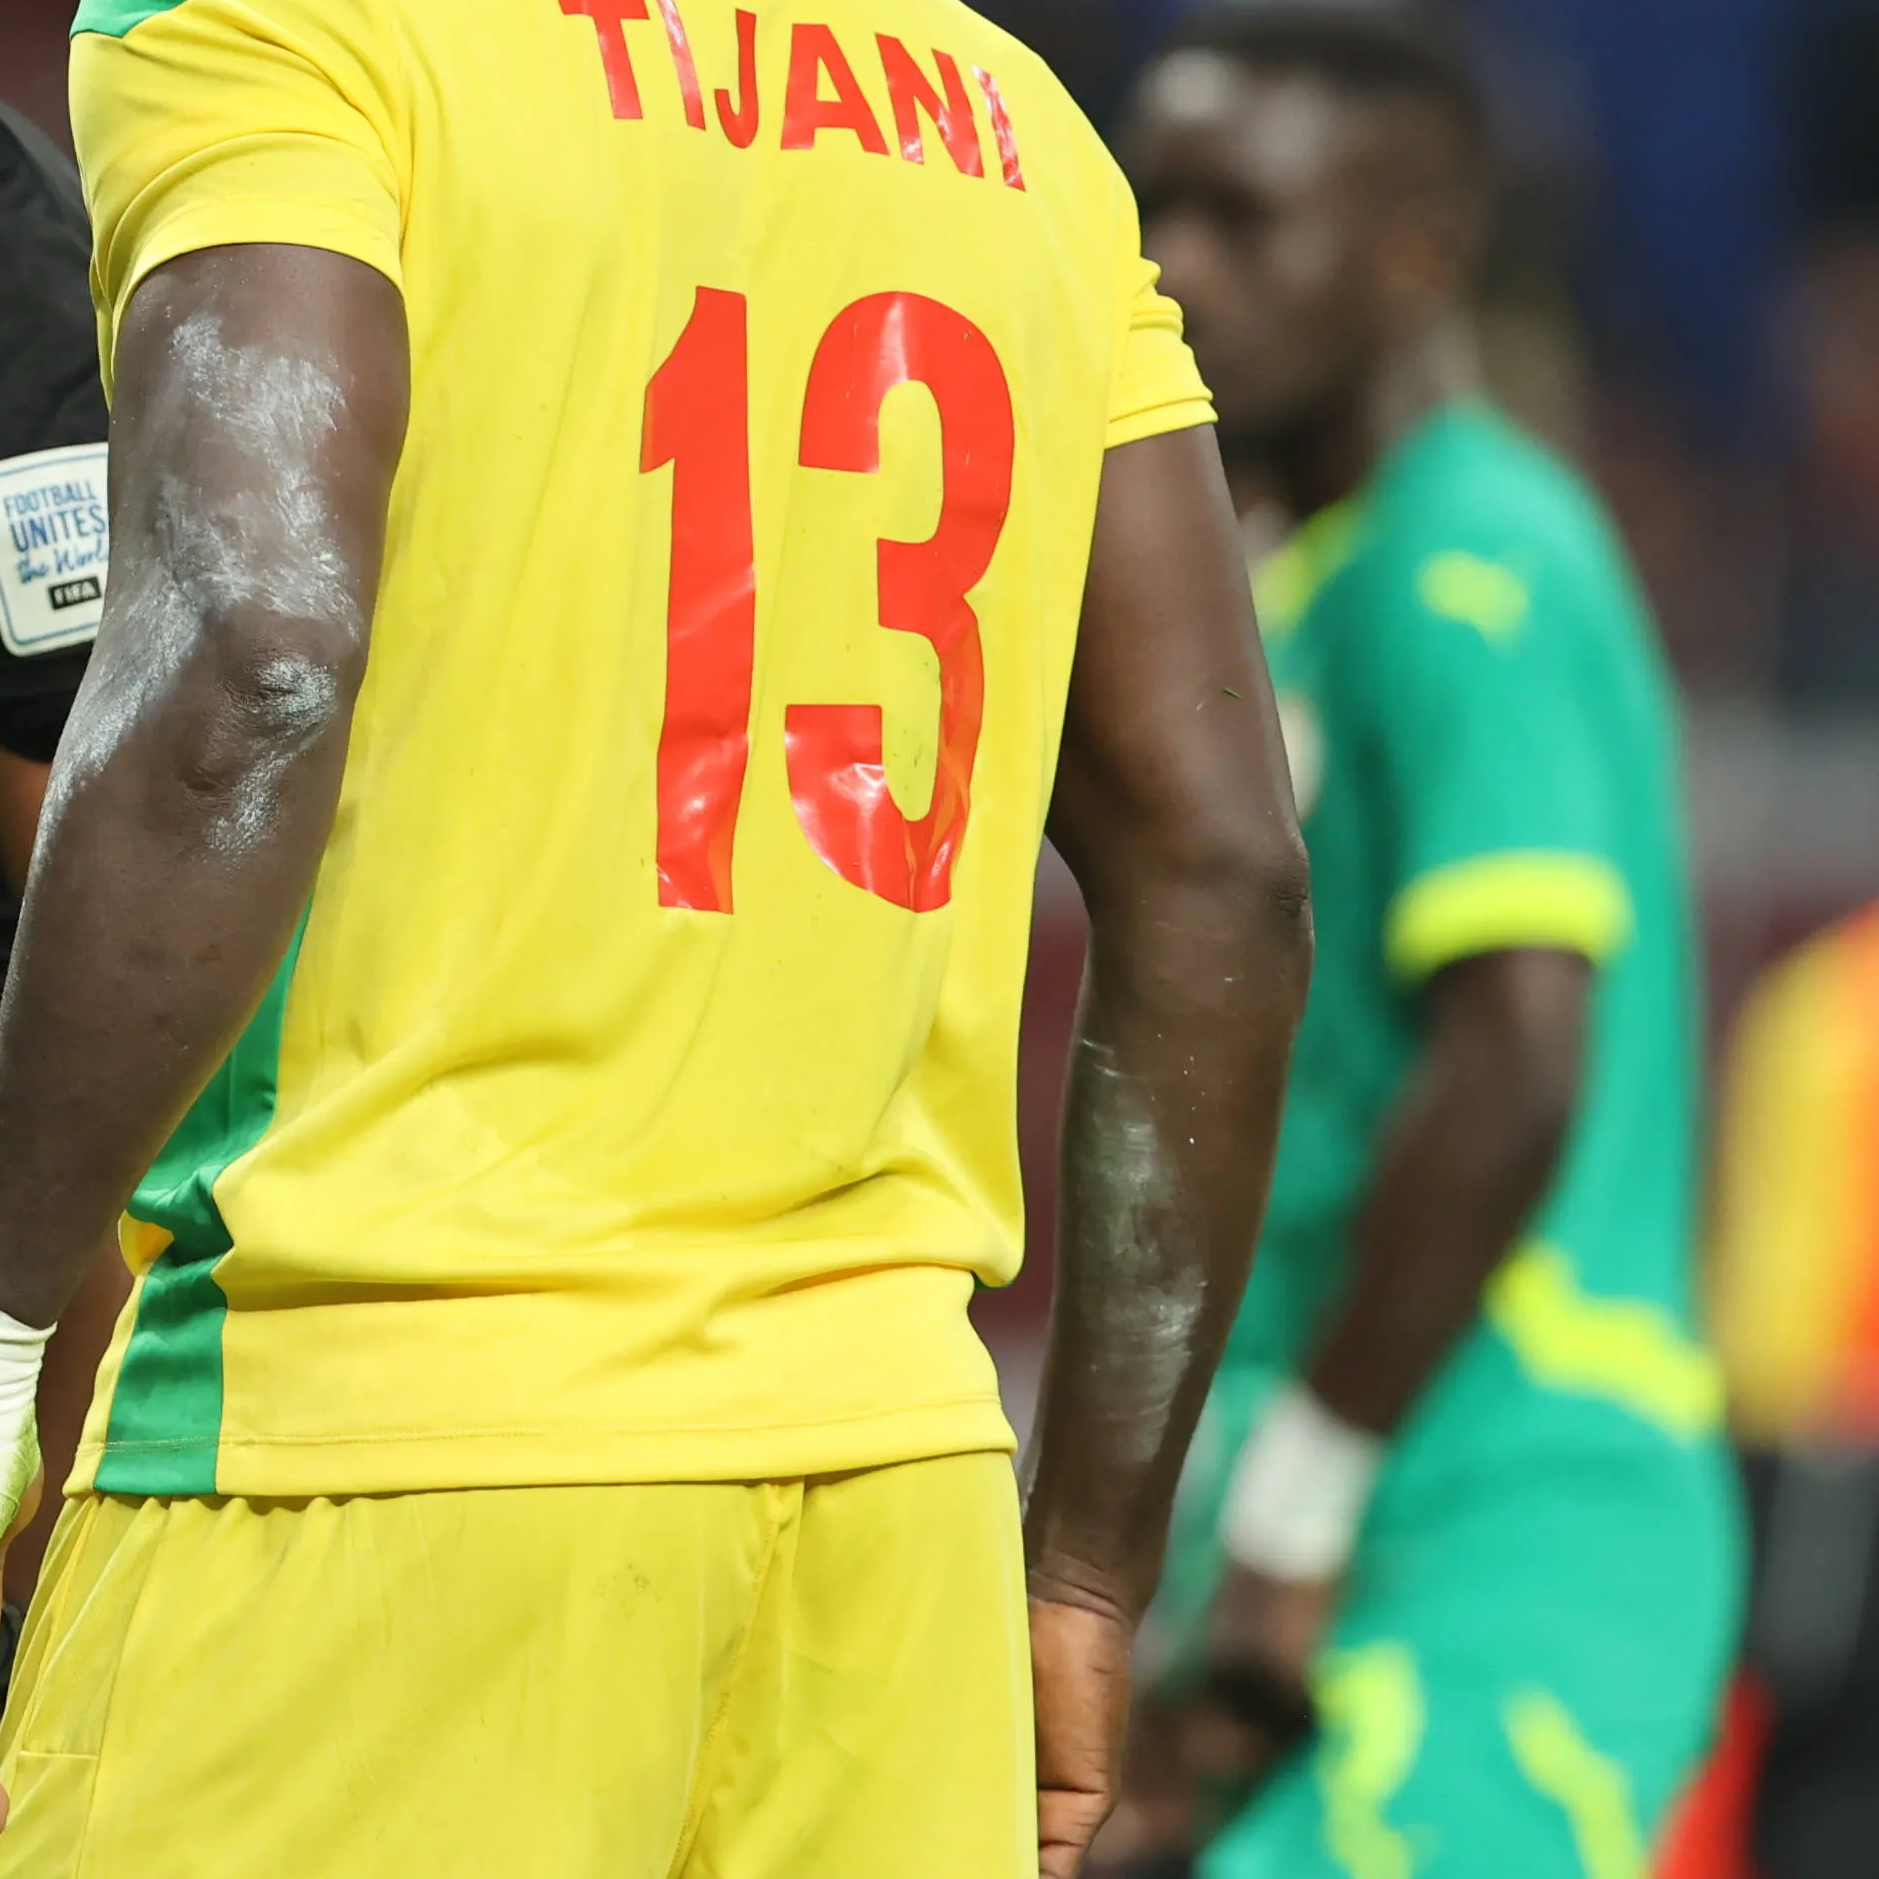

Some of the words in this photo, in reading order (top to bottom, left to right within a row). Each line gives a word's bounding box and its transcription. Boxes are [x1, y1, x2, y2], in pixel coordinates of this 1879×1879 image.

[2, 479, 98, 518] FOOTBALL
[9, 504, 108, 553] UNITES
[54, 537, 109, 575] Worl
[53, 579, 99, 606] FIFA
[639, 285, 1015, 915] 13
